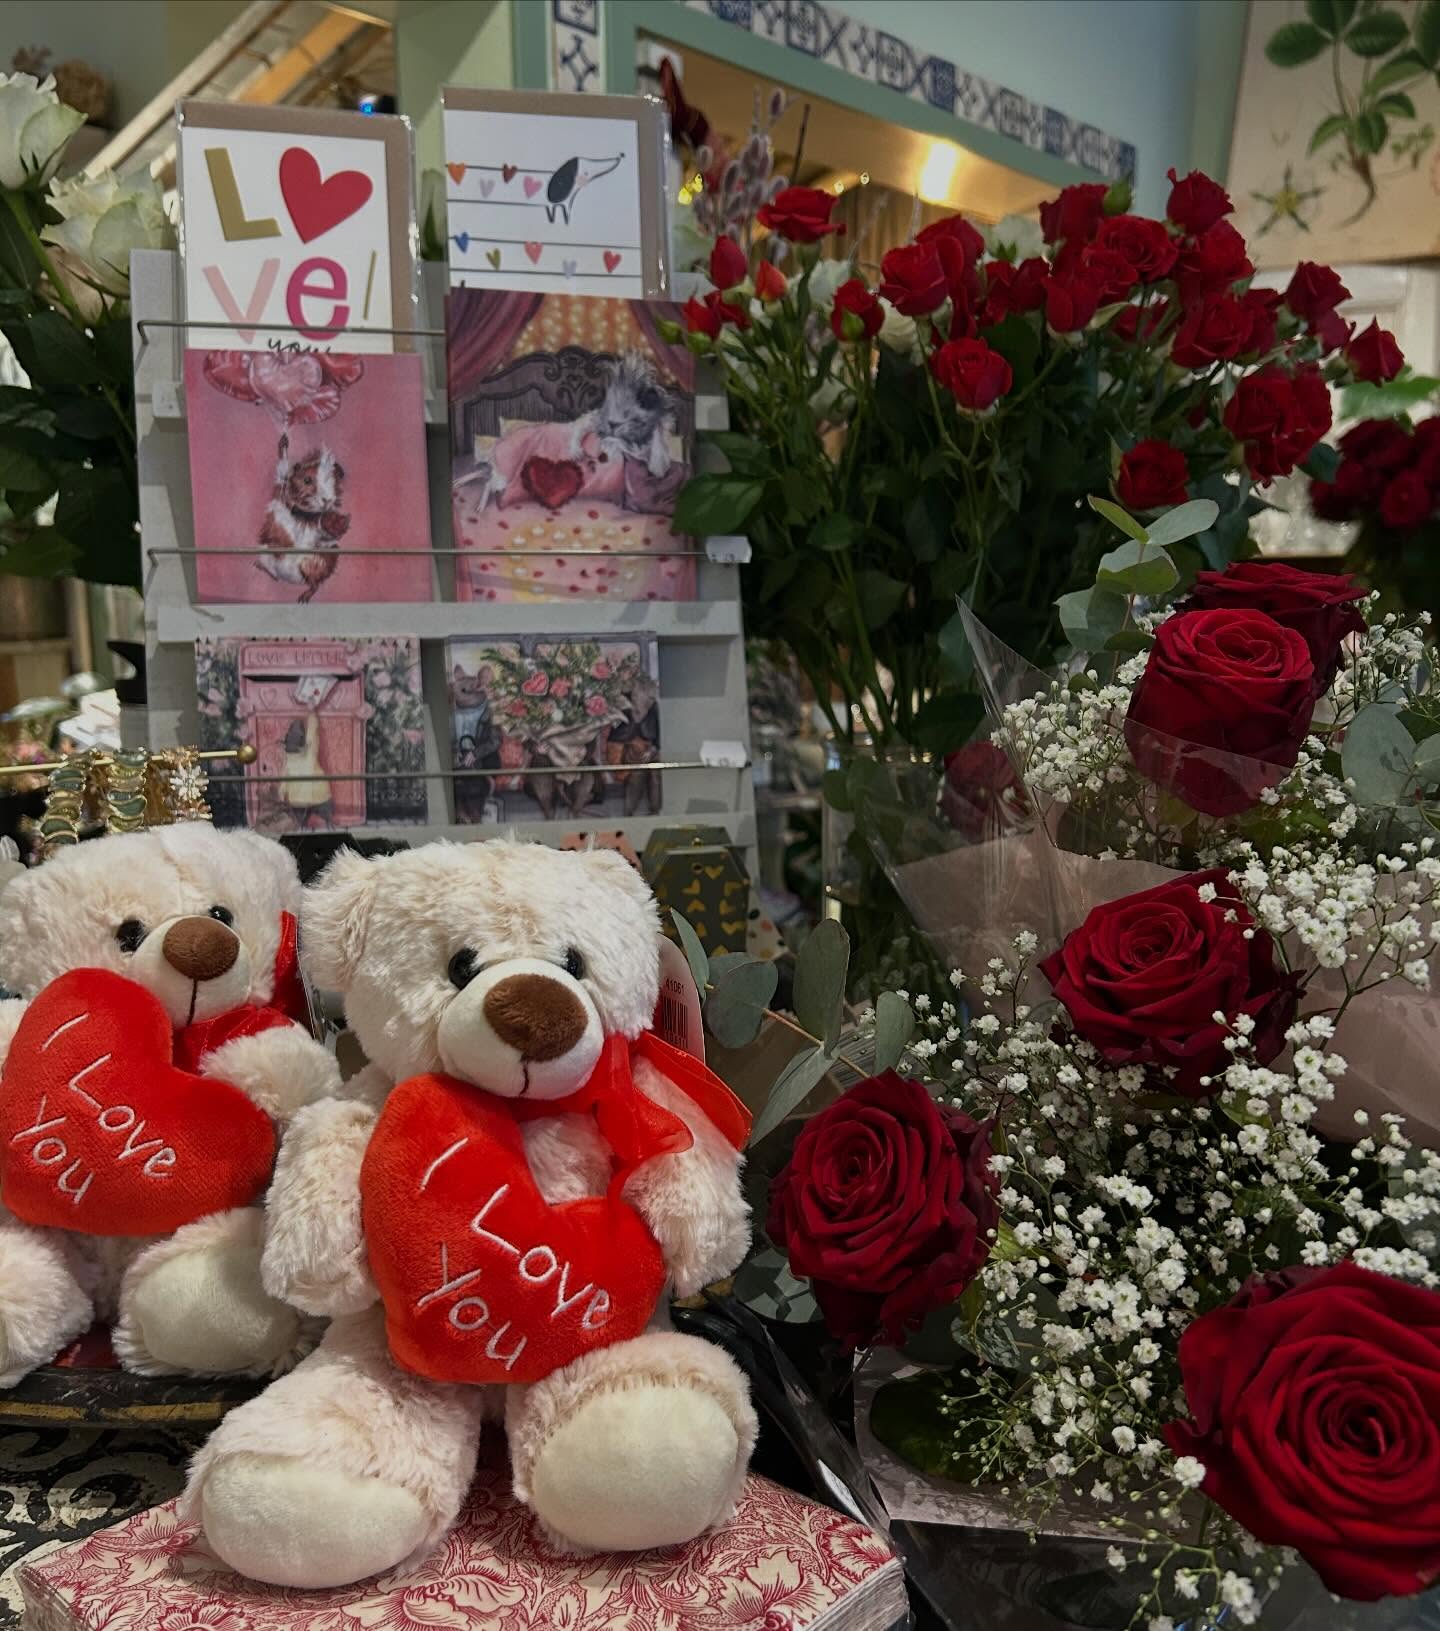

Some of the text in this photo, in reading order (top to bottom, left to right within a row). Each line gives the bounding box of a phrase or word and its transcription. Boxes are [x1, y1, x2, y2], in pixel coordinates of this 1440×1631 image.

[40, 1012, 90, 1052] I
[11, 1094, 96, 1205] You
[68, 1052, 177, 1178] Love
[420, 1136, 469, 1191] I
[416, 1241, 528, 1371] You
[470, 1183, 610, 1330] Love
